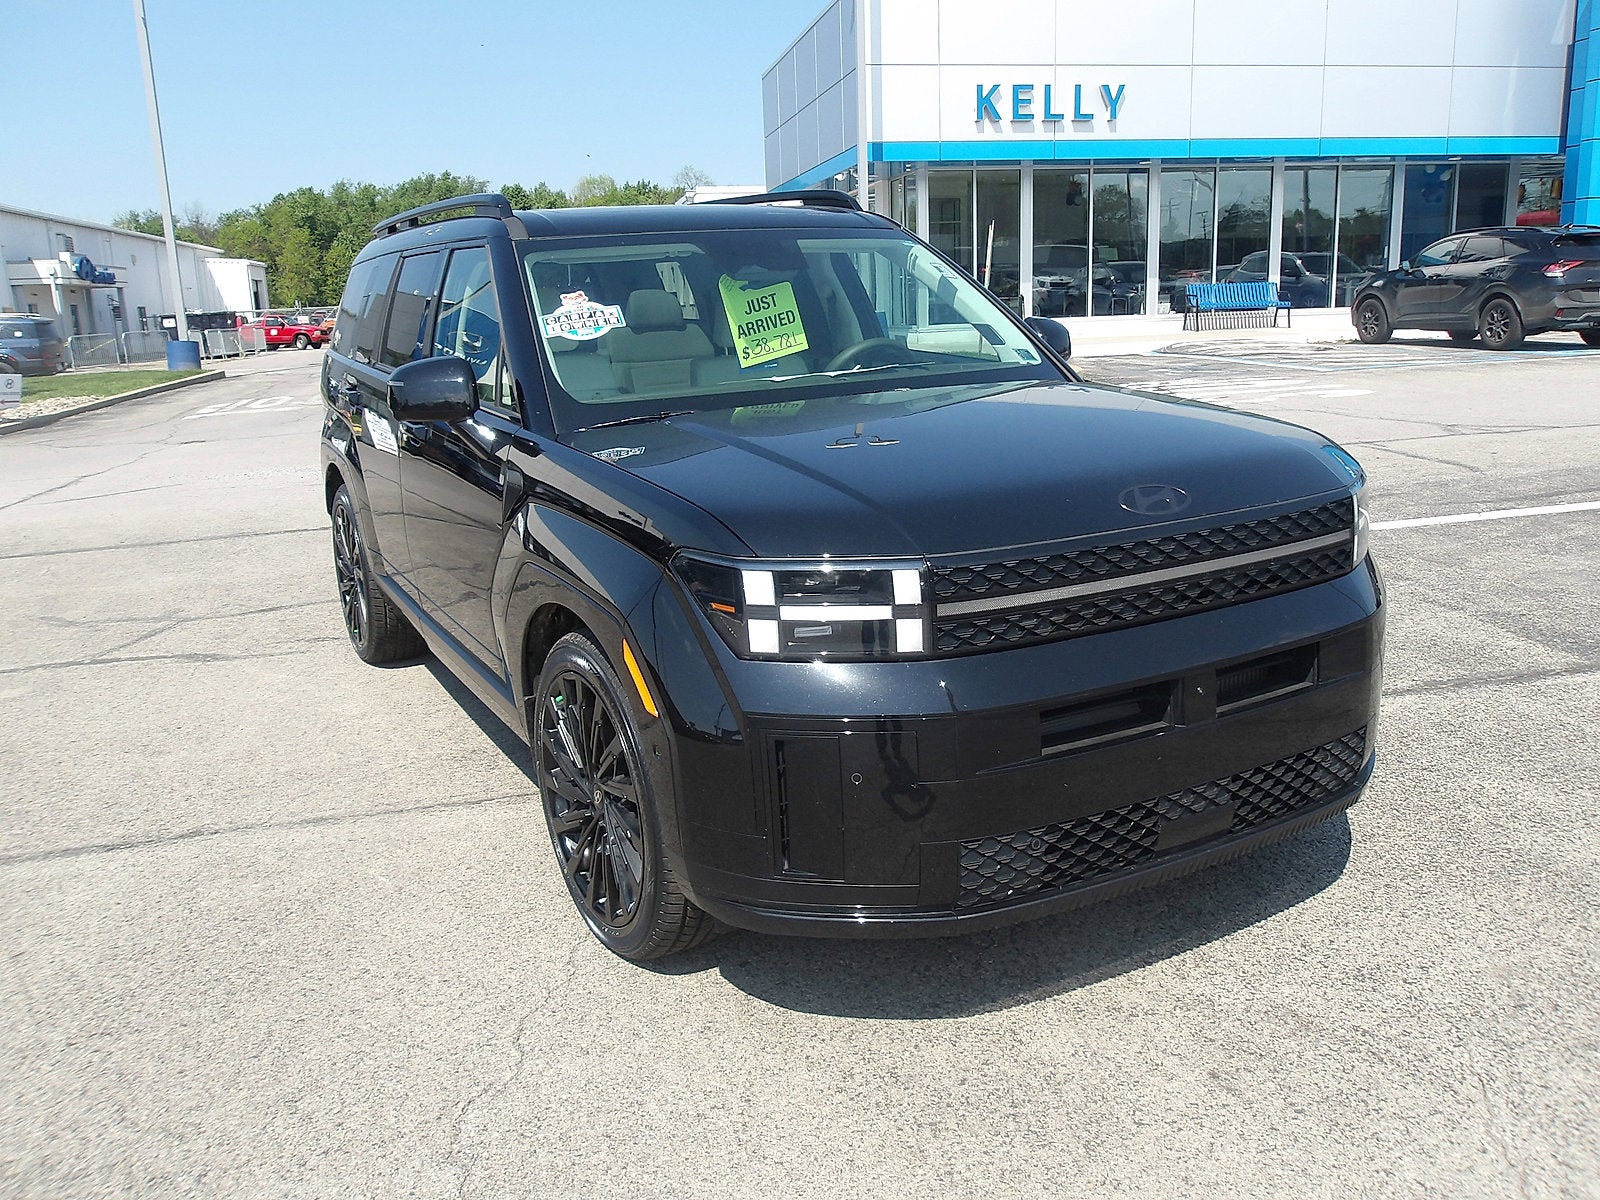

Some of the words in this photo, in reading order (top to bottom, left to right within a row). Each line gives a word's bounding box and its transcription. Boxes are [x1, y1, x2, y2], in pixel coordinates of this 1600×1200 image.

[976, 84, 1126, 120] KELLY
[744, 293, 777, 316] JUST
[737, 309, 796, 340] ARRIVED
